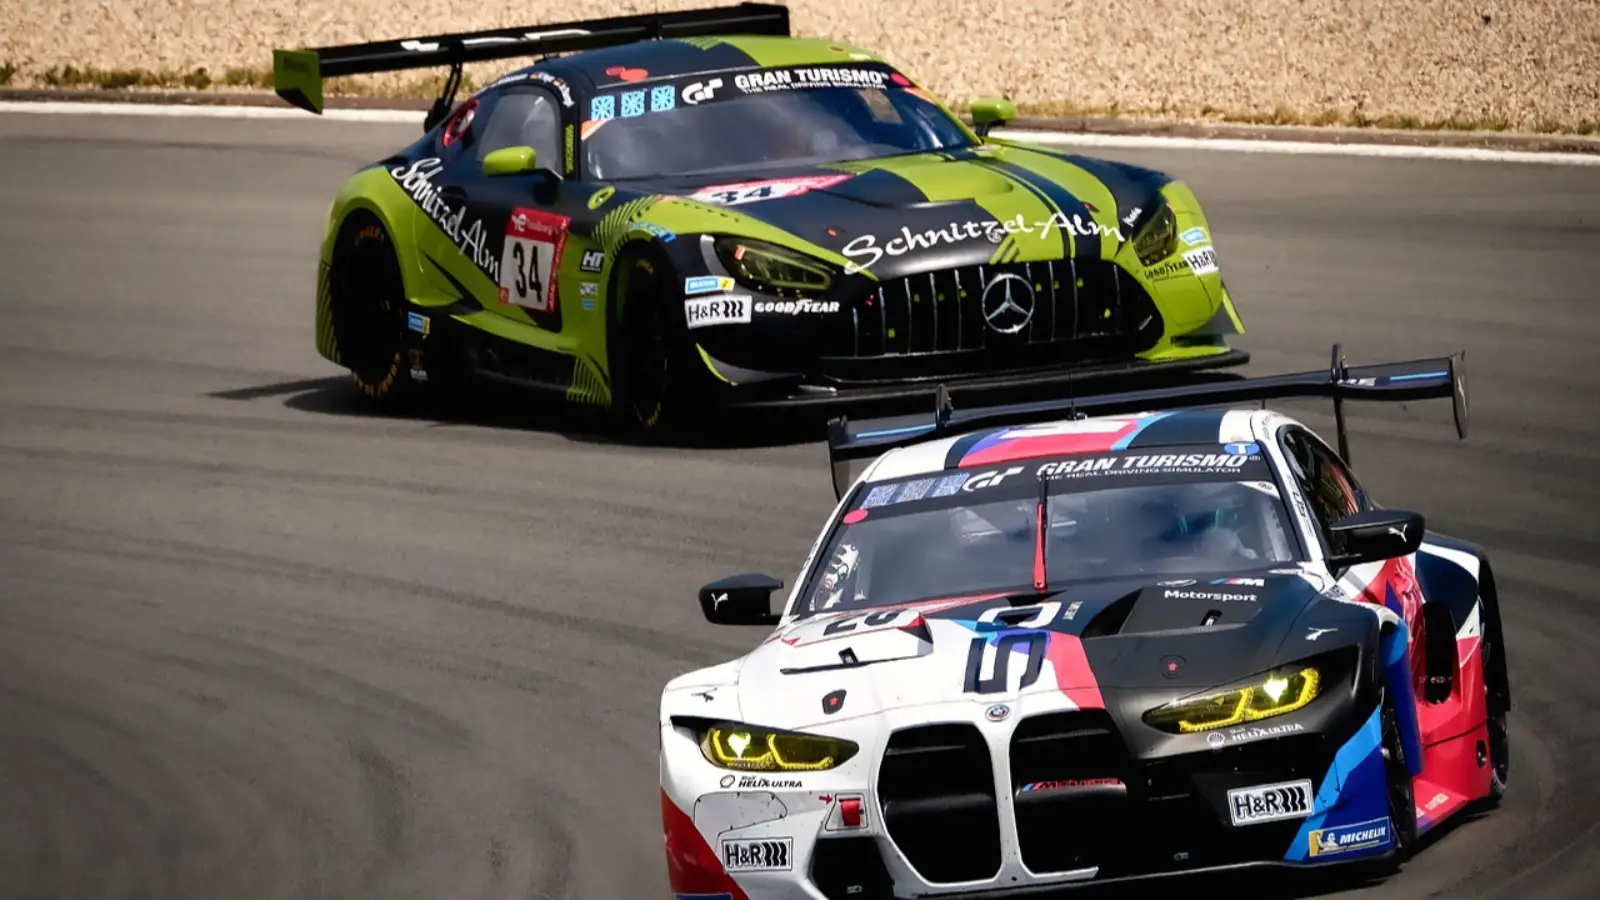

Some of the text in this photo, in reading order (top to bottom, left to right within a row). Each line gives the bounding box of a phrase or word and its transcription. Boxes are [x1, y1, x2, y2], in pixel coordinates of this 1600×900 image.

[734, 70, 791, 89] GRAN
[711, 185, 773, 203] 34
[842, 211, 1125, 275] Schnitzel-Alm
[512, 241, 542, 303] 34
[688, 301, 720, 323] H&R
[754, 298, 840, 316] GOODYEAR
[1036, 457, 1118, 476] GRAN
[1162, 466, 1241, 474] SIMULATOR
[1164, 590, 1258, 602] Motorsport
[738, 778, 803, 788] HELIX ULTRA
[1234, 791, 1279, 817] H&R
[1339, 826, 1386, 845] MICHELIN
[725, 843, 762, 866] H&R
